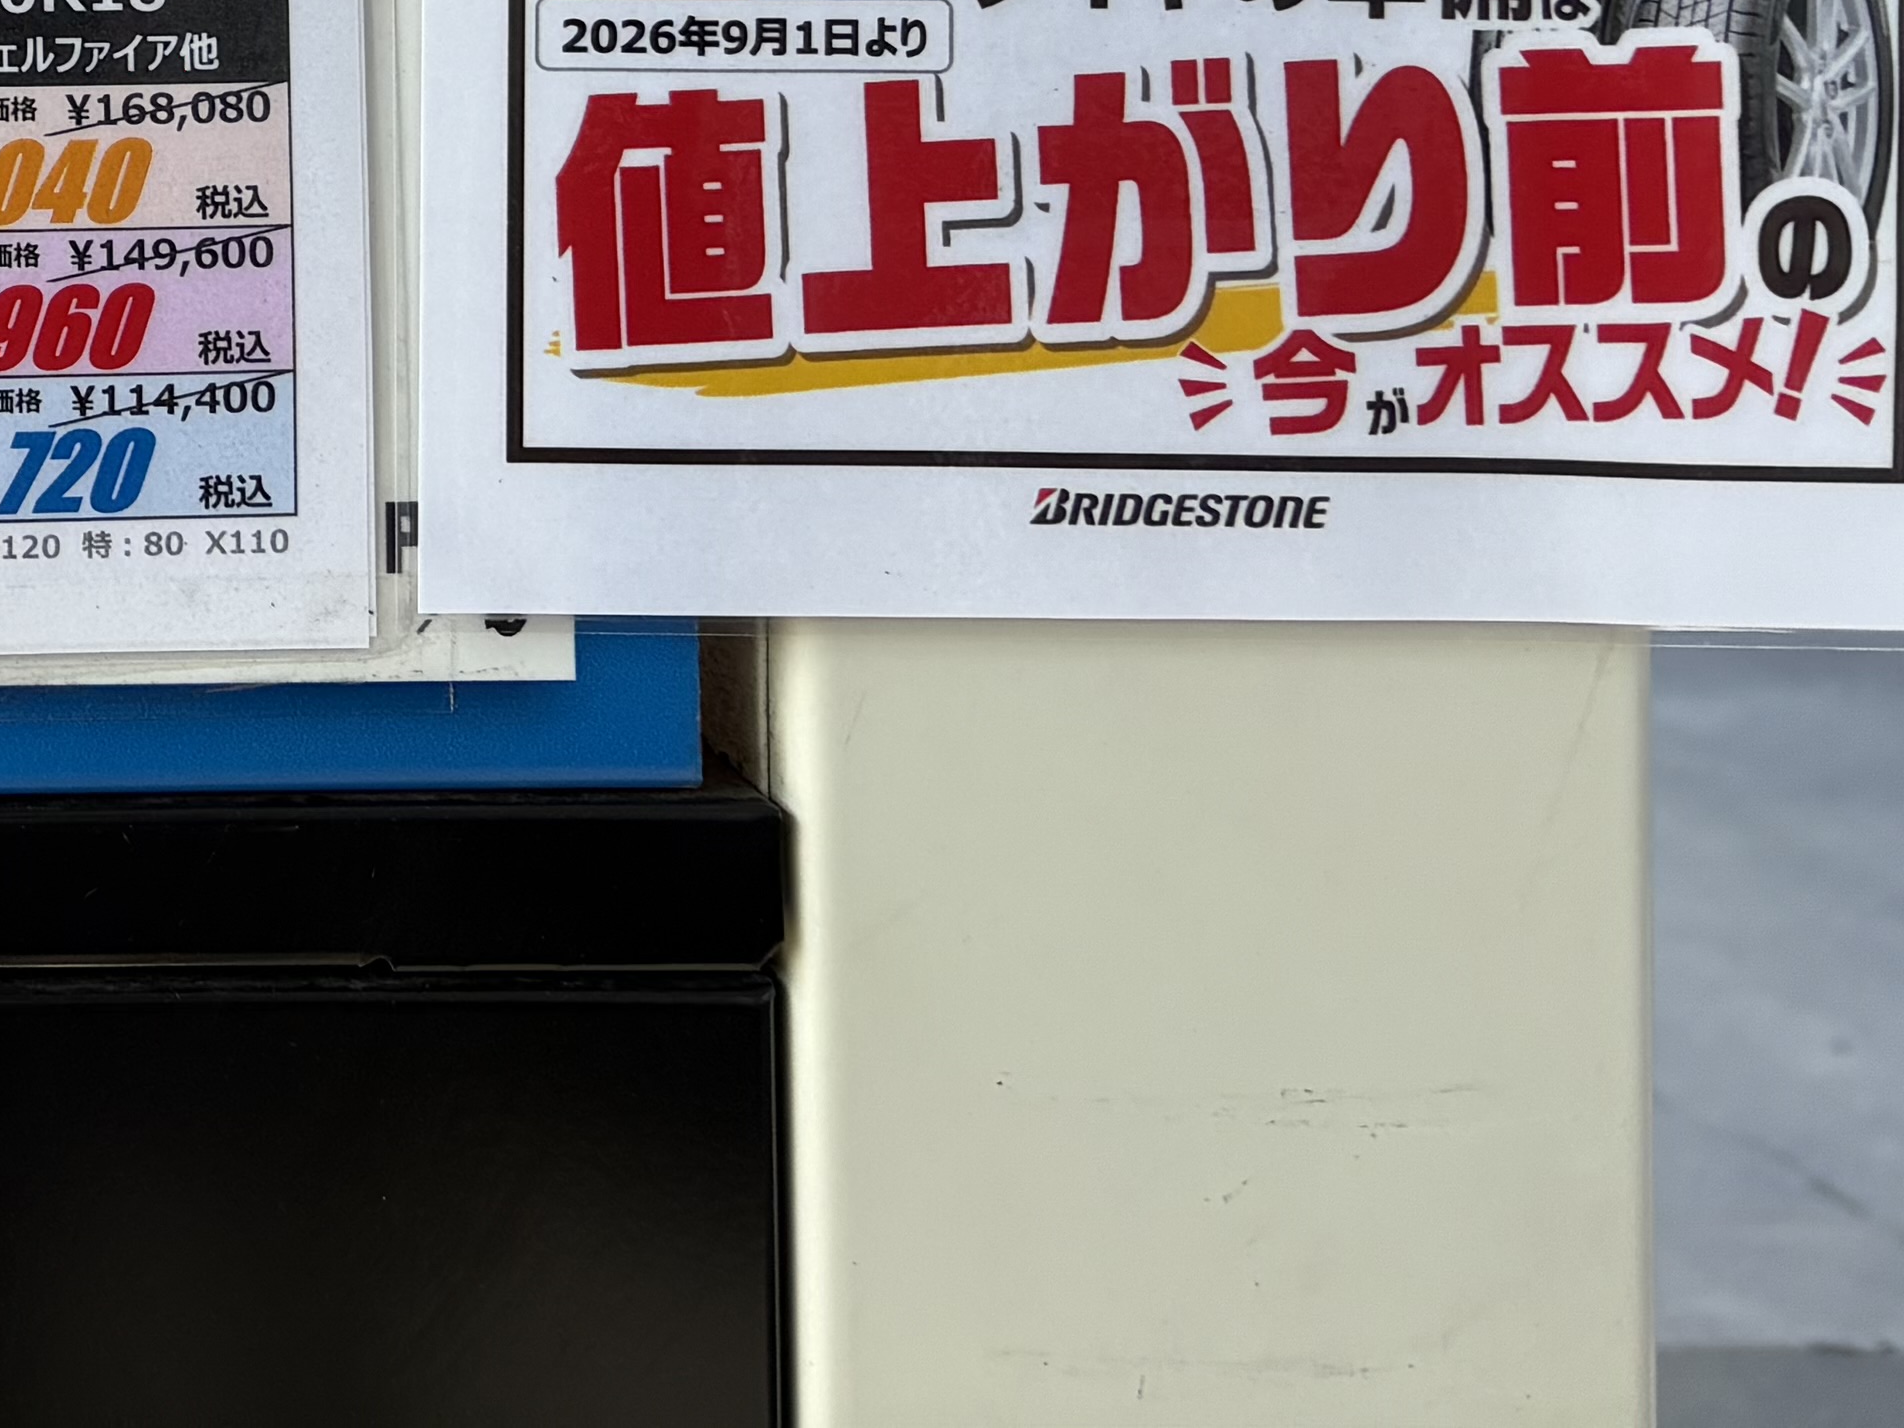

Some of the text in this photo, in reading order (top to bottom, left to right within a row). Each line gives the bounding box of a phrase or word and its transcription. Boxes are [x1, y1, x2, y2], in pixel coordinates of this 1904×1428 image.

[561, 16, 929, 61] 2026年9月1日より
[65, 89, 271, 127] ¥168,080
[555, 43, 1852, 354] 値上がり前の
[1029, 488, 1331, 531] BRIDGESTONE
[205, 529, 288, 554] X110
